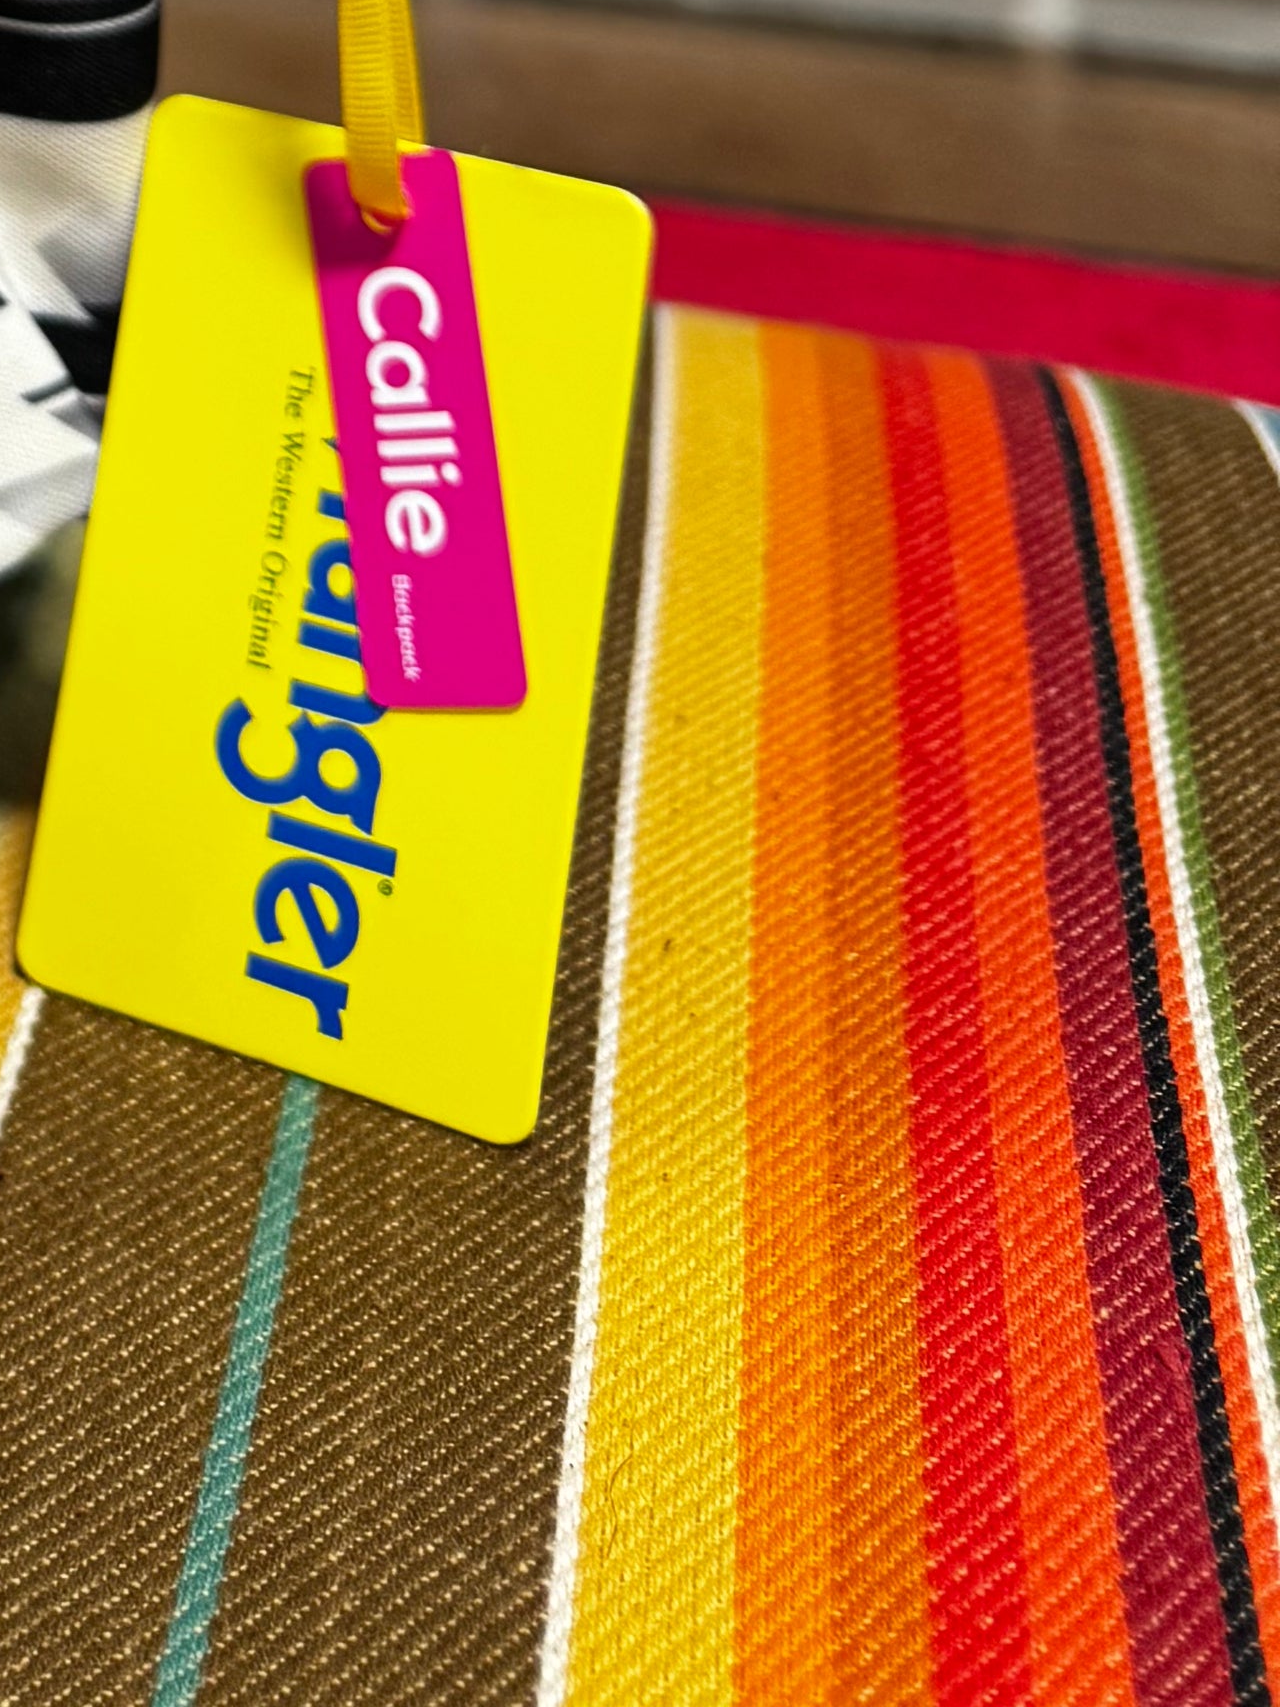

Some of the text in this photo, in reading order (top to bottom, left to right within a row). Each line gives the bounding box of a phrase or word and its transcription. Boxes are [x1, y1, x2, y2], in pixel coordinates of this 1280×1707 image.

[246, 365, 317, 672] The Western Original
[356, 265, 464, 558] Callie
[391, 573, 423, 683] Backpack
